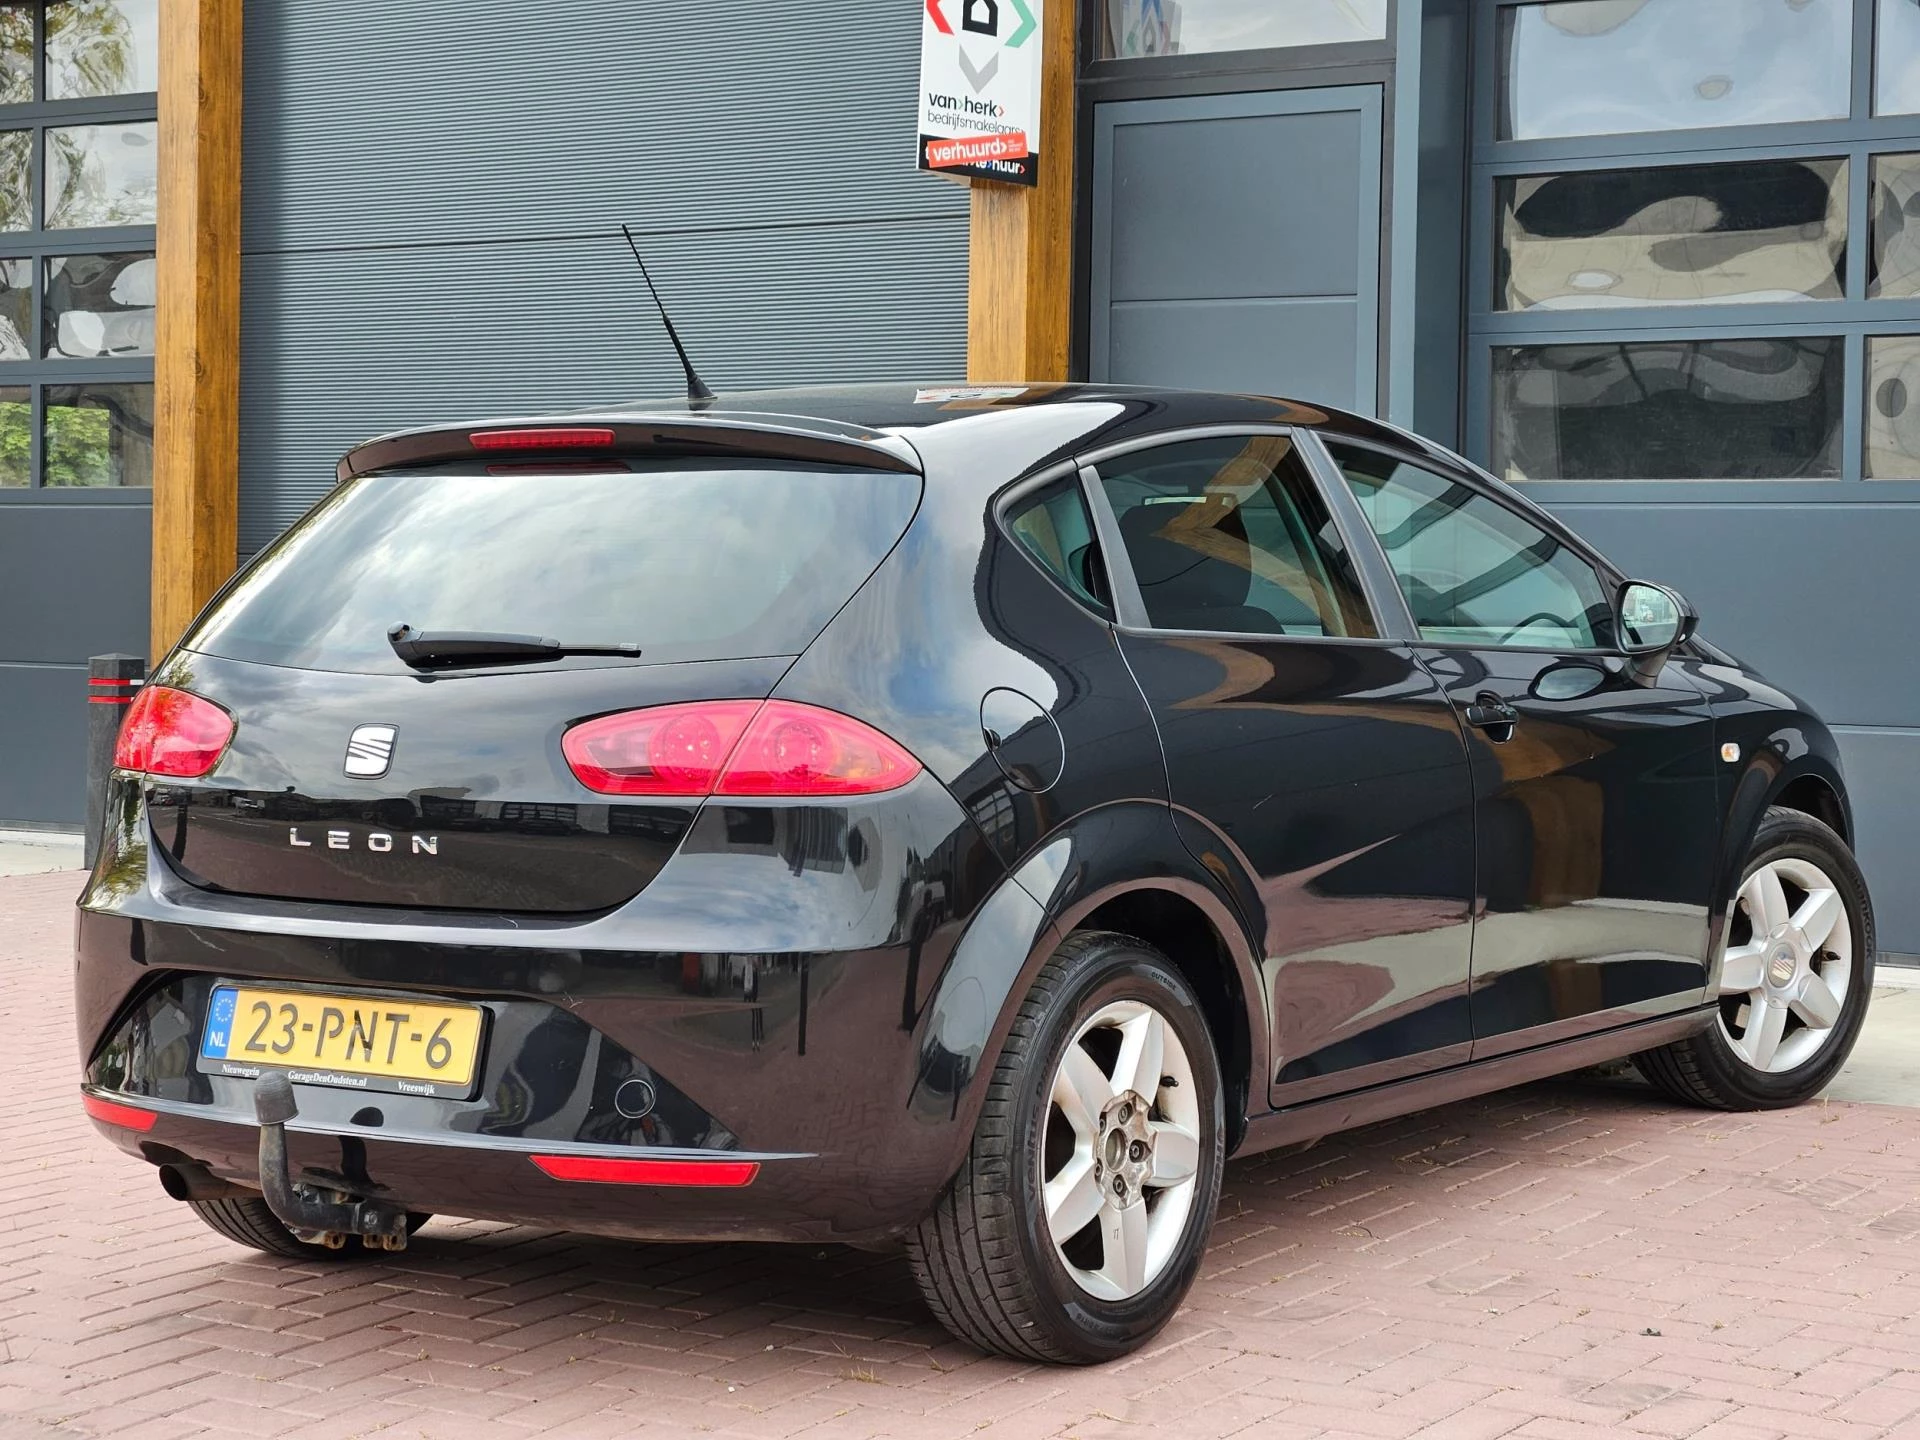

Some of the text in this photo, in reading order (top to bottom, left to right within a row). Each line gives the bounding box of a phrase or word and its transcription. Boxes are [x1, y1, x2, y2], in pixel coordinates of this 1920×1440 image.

[929, 93, 998, 117] van herk
[933, 138, 1000, 161] verhuurd
[289, 827, 438, 855] LEON
[209, 1000, 452, 1070] NL 23-PNT-6
[222, 1064, 436, 1095] Nieuwegein GarageDenOudsten.nl Vreeswijk
